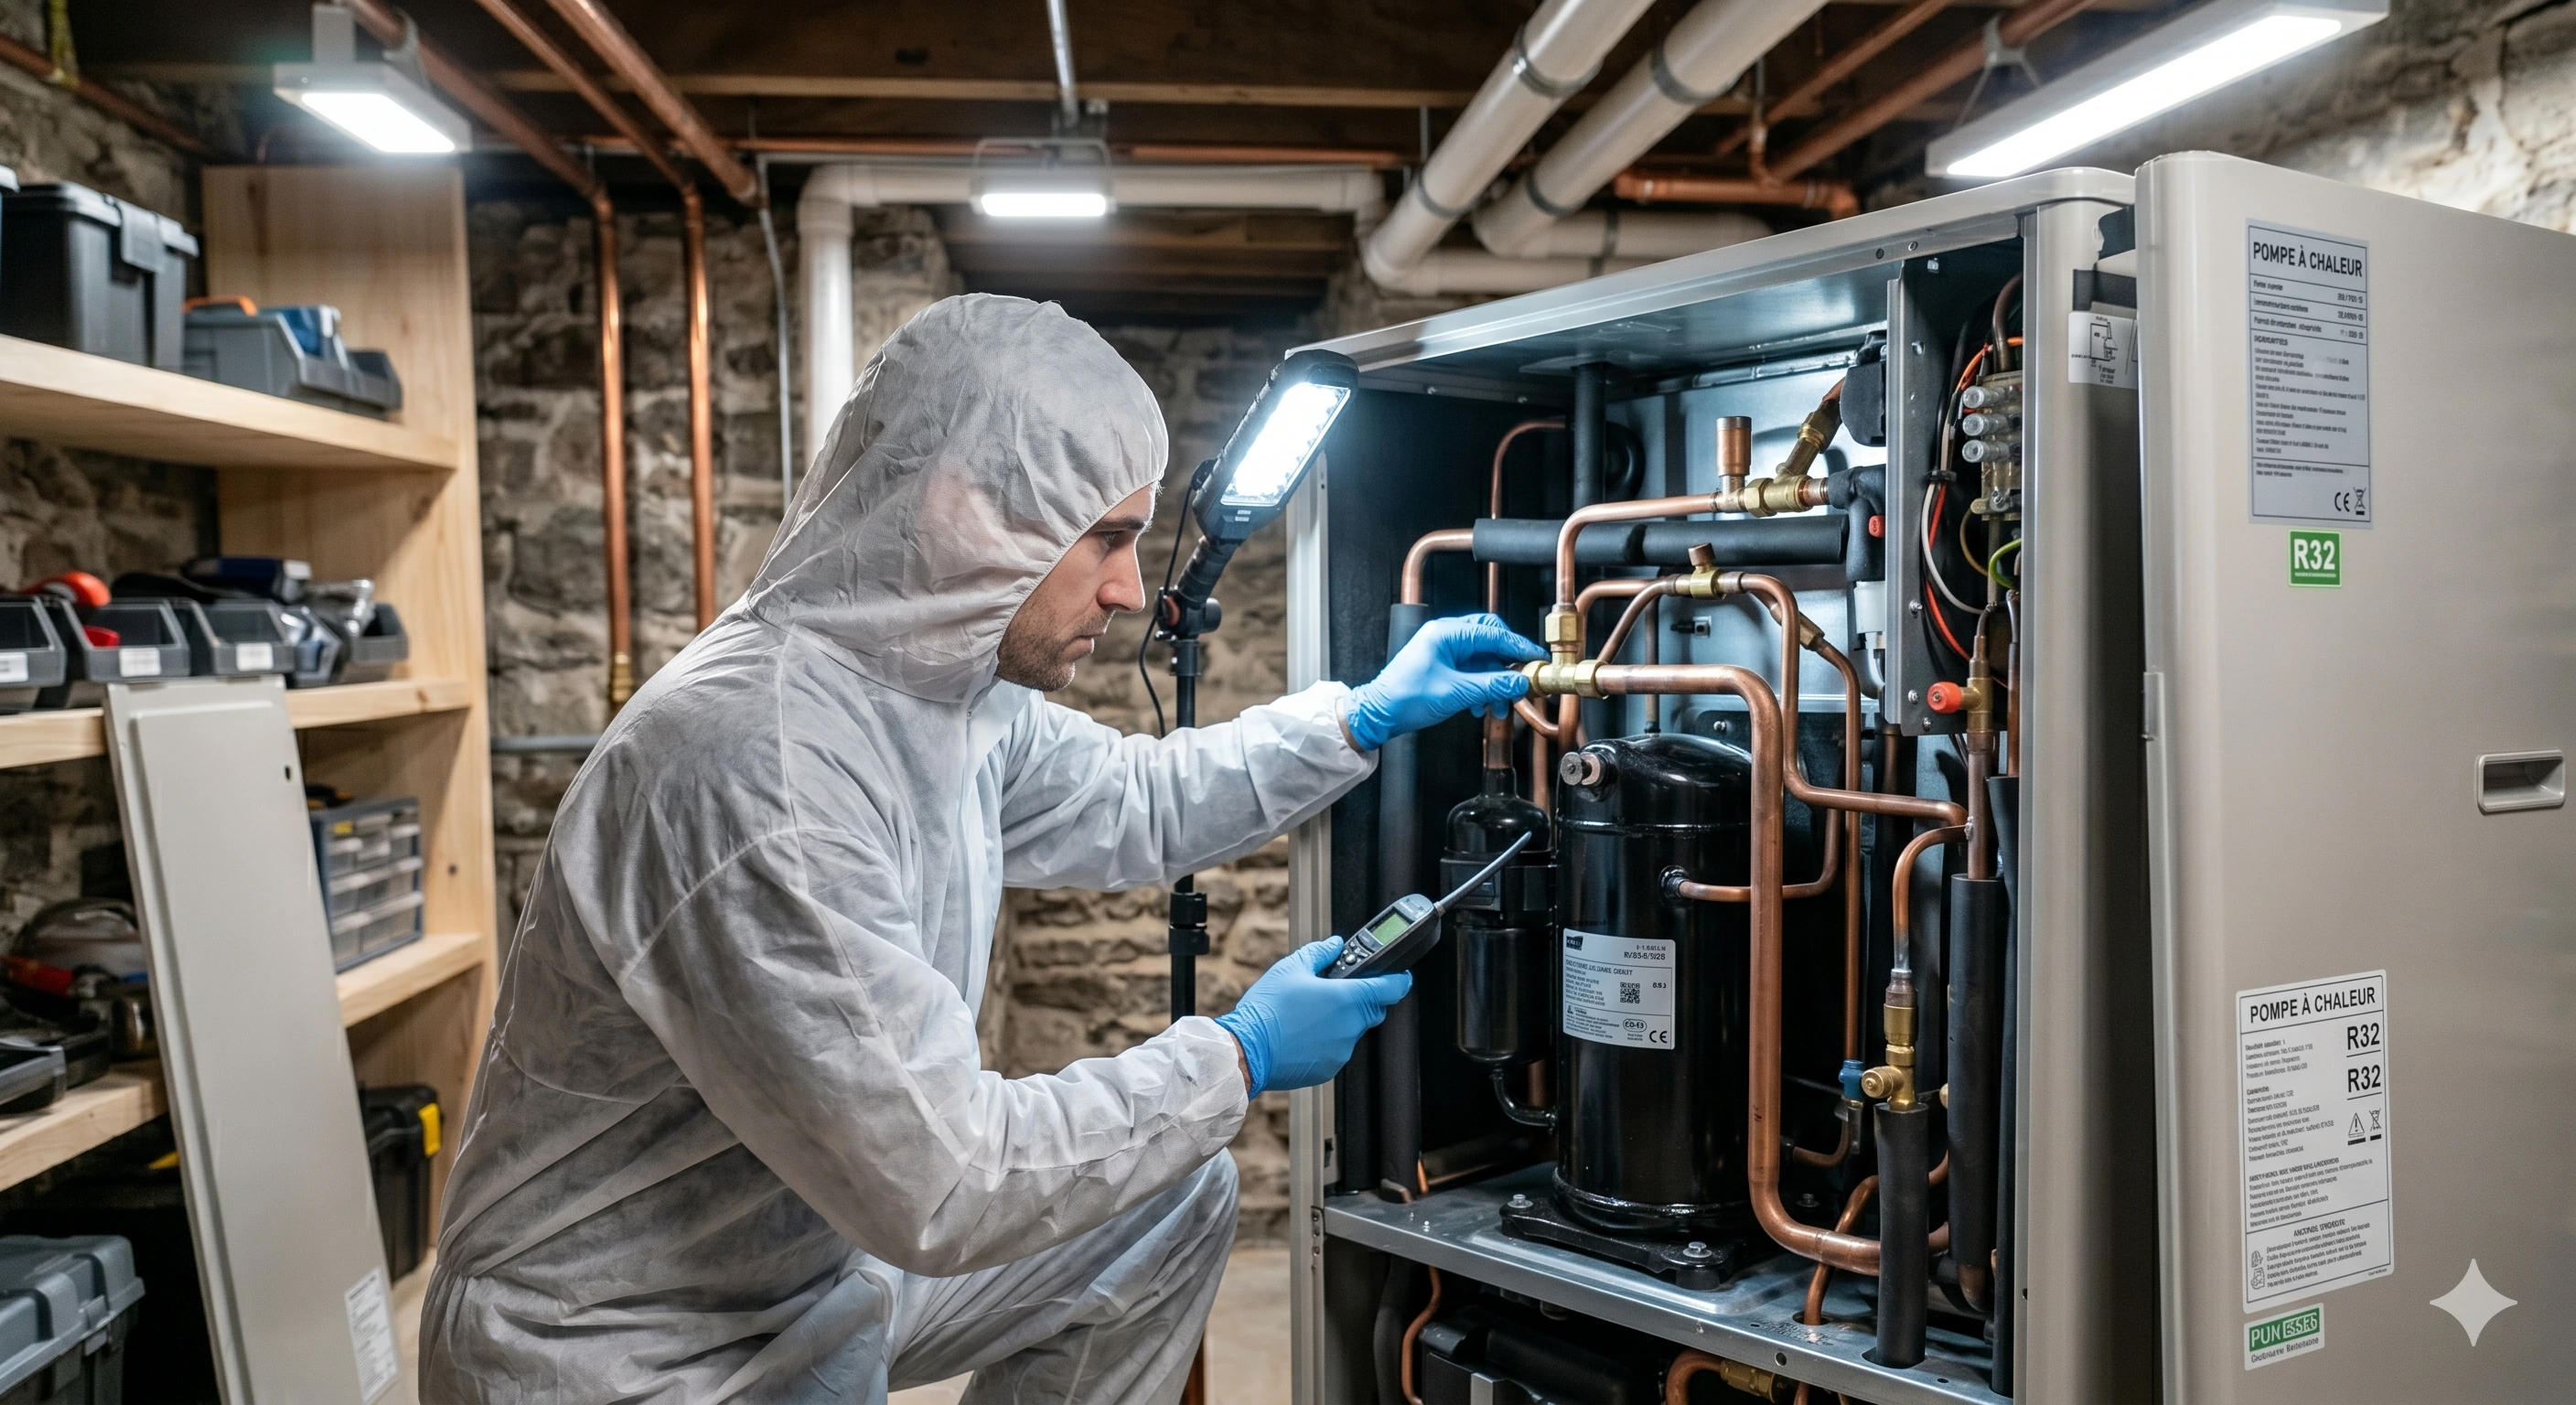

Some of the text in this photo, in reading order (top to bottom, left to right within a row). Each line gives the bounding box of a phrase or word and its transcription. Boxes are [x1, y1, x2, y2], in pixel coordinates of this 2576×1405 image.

[2253, 241, 2363, 277] POMPE À CHALEUR
[2293, 538, 2336, 571] R32
[2250, 986, 2376, 1024] POMPE À CHALEUR
[2346, 1022, 2380, 1050] R32
[2347, 1064, 2381, 1092] R32
[2251, 1324, 2281, 1348] PUN
